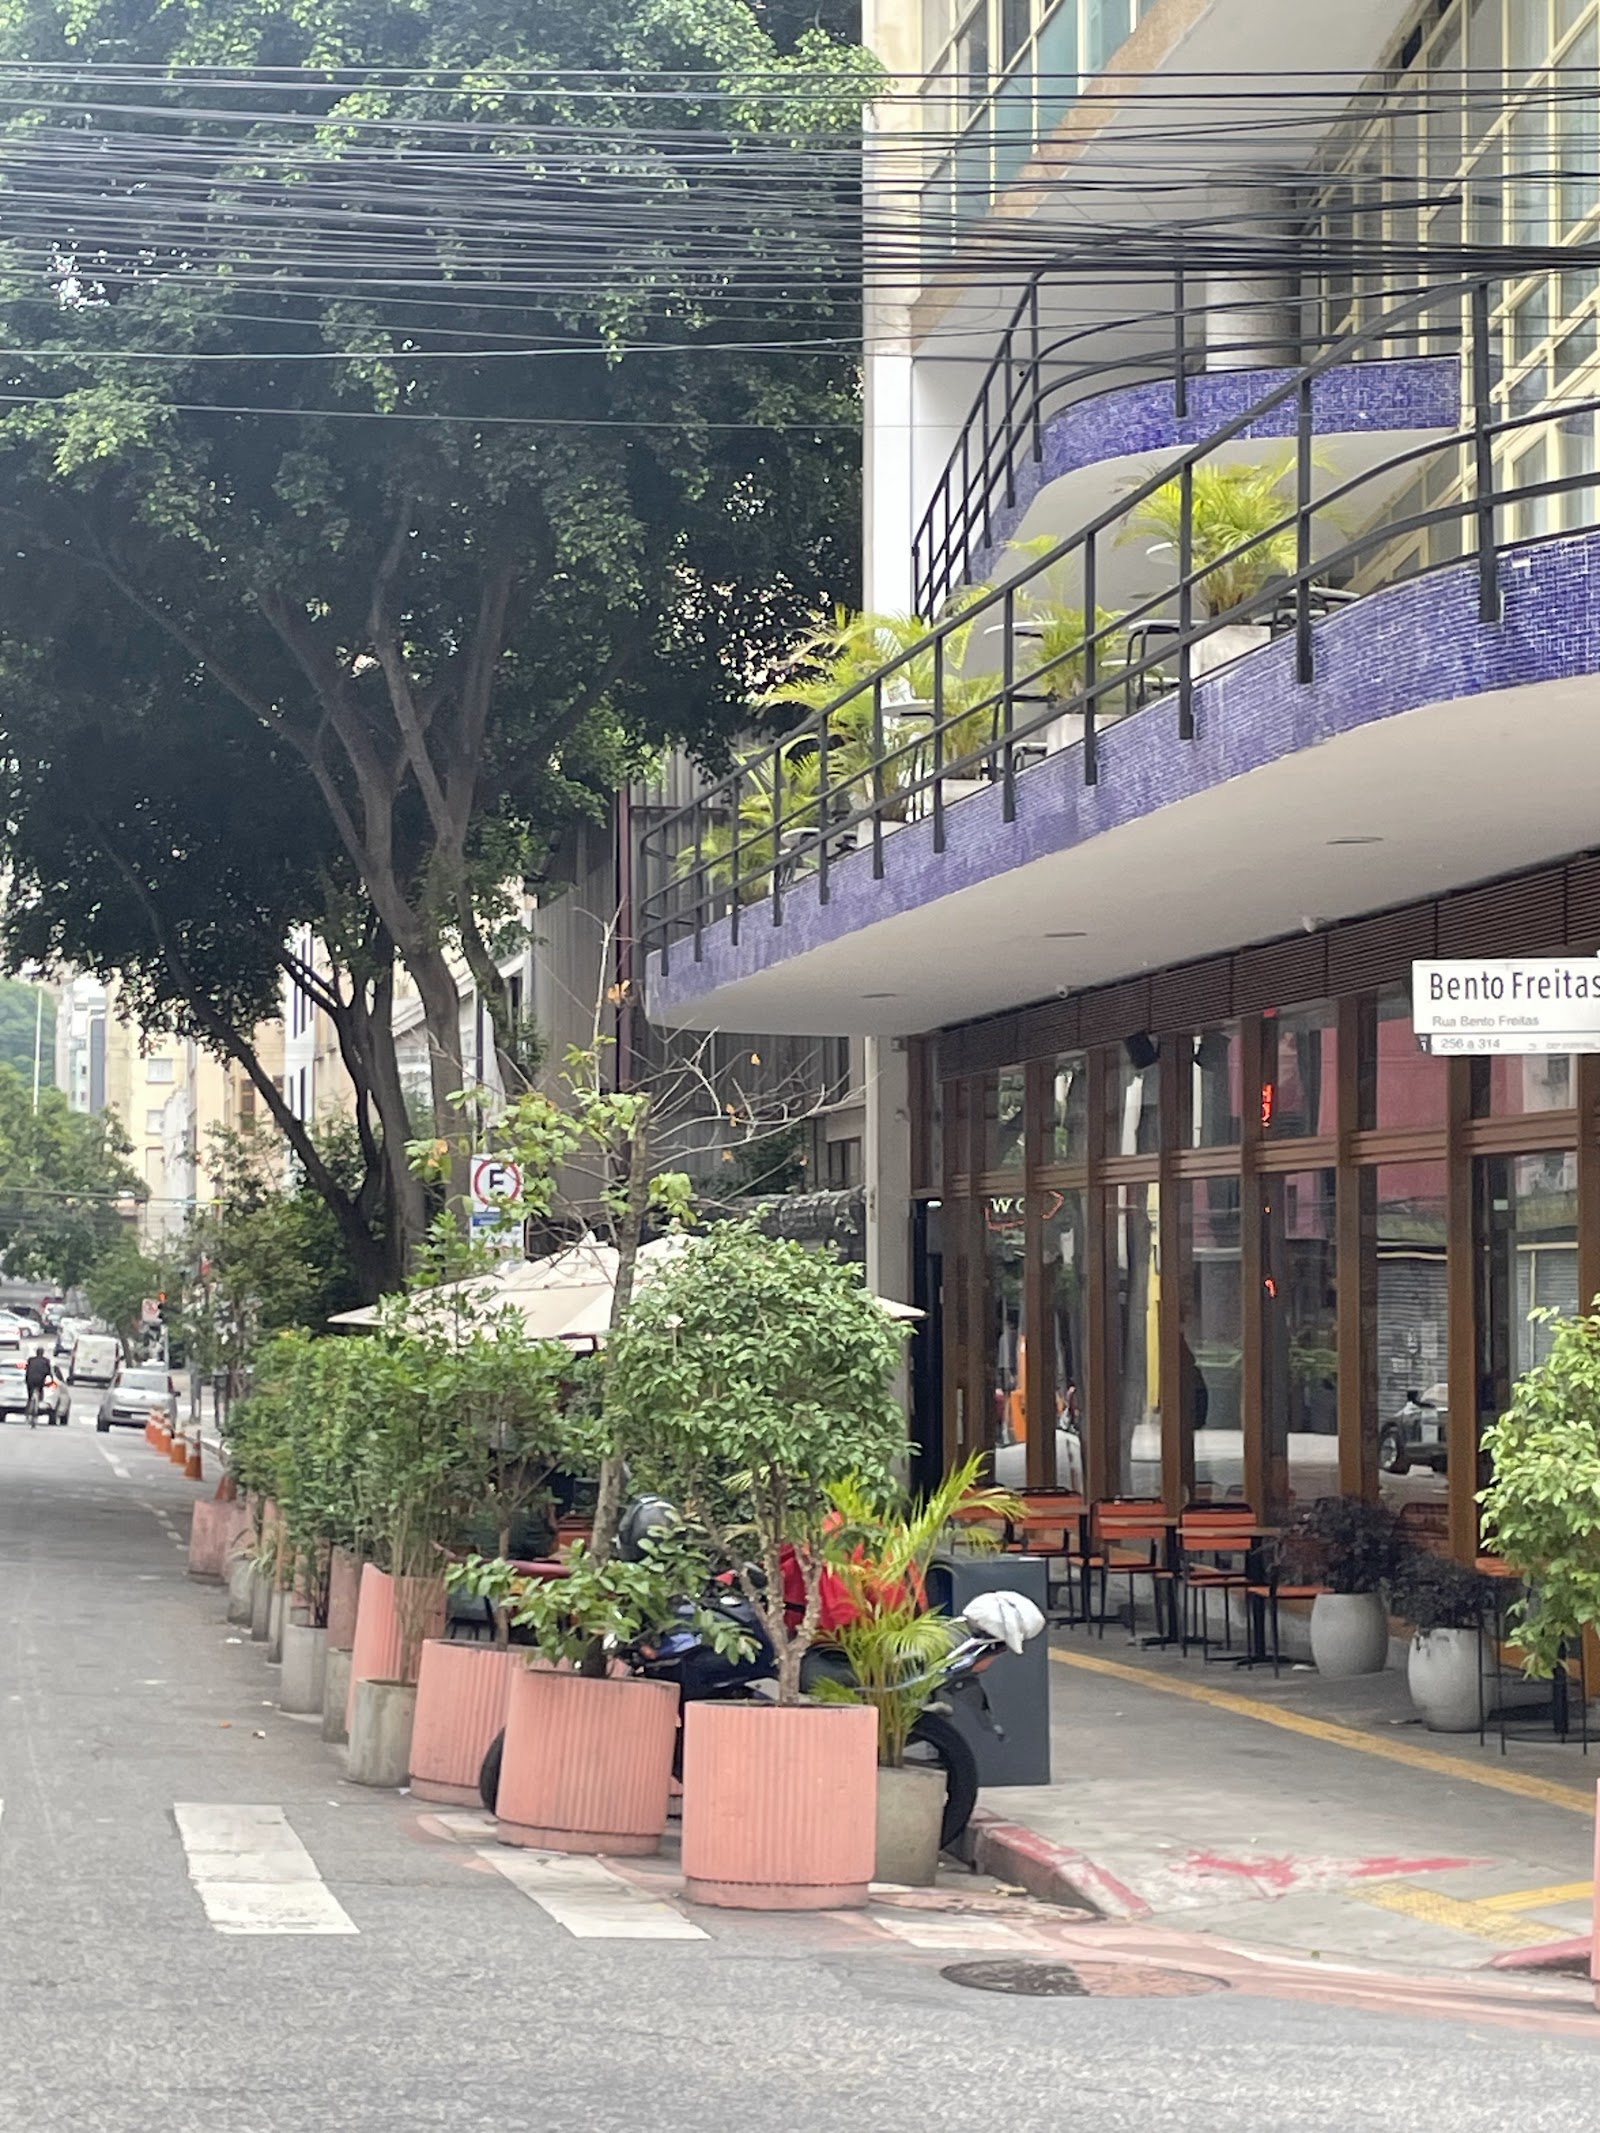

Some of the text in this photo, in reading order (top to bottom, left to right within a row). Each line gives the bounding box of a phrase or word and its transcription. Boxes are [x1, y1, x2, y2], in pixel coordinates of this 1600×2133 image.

[1430, 971, 1504, 1000] Bento
[1432, 1014, 1539, 1027] Rua Bento Freitas
[1441, 1038, 1501, 1049] 256 a 314
